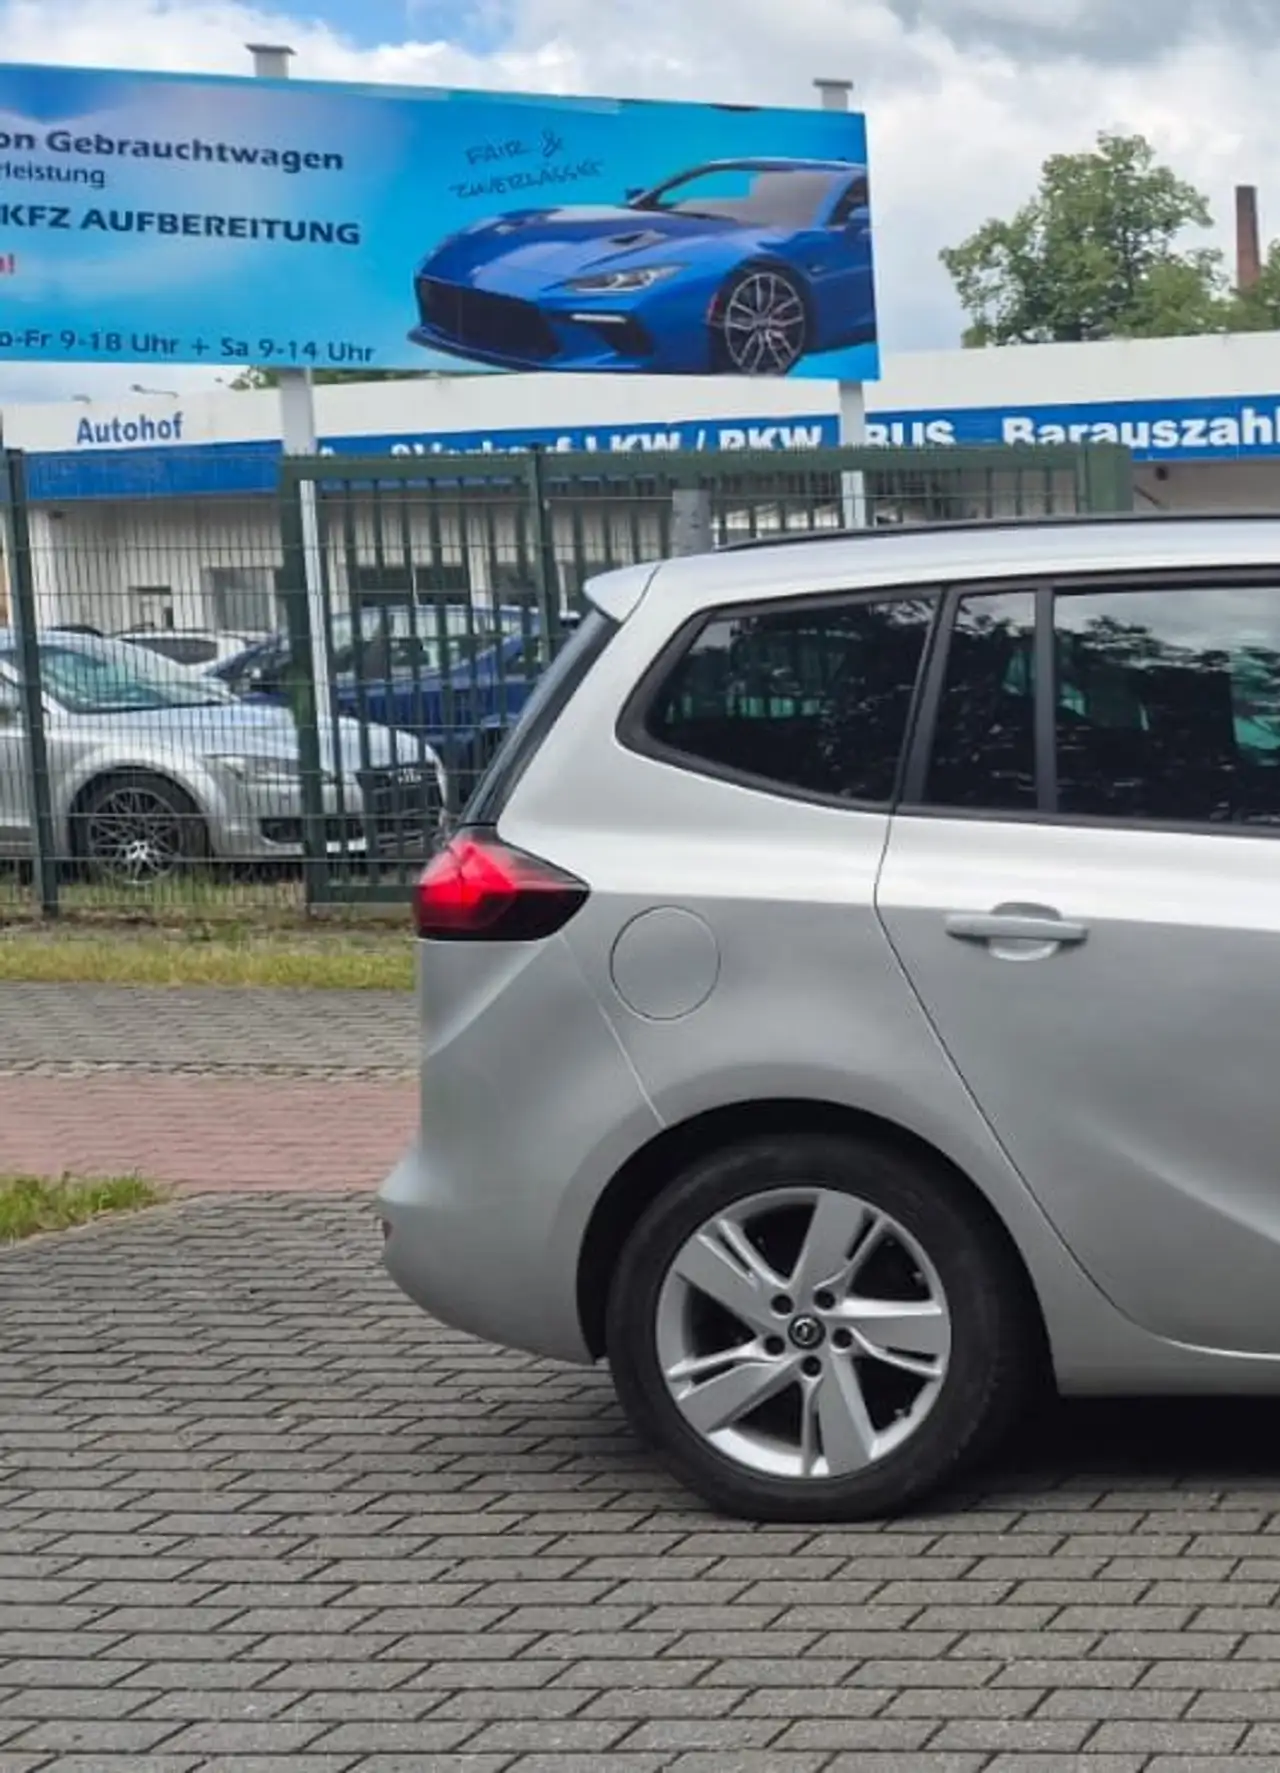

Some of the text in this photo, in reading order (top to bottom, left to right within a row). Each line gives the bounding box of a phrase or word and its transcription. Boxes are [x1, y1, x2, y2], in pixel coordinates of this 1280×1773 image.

[45, 130, 344, 174] Gebrauchtwagen
[1, 203, 361, 245] KFZ AUFBEREITUNG
[60, 332, 122, 352] 9-18
[131, 334, 179, 355] Uhr
[191, 338, 210, 356] +
[220, 337, 249, 358] Sa
[259, 338, 317, 361] 9-14
[328, 342, 376, 363] Uhr
[76, 411, 183, 444] Autohof
